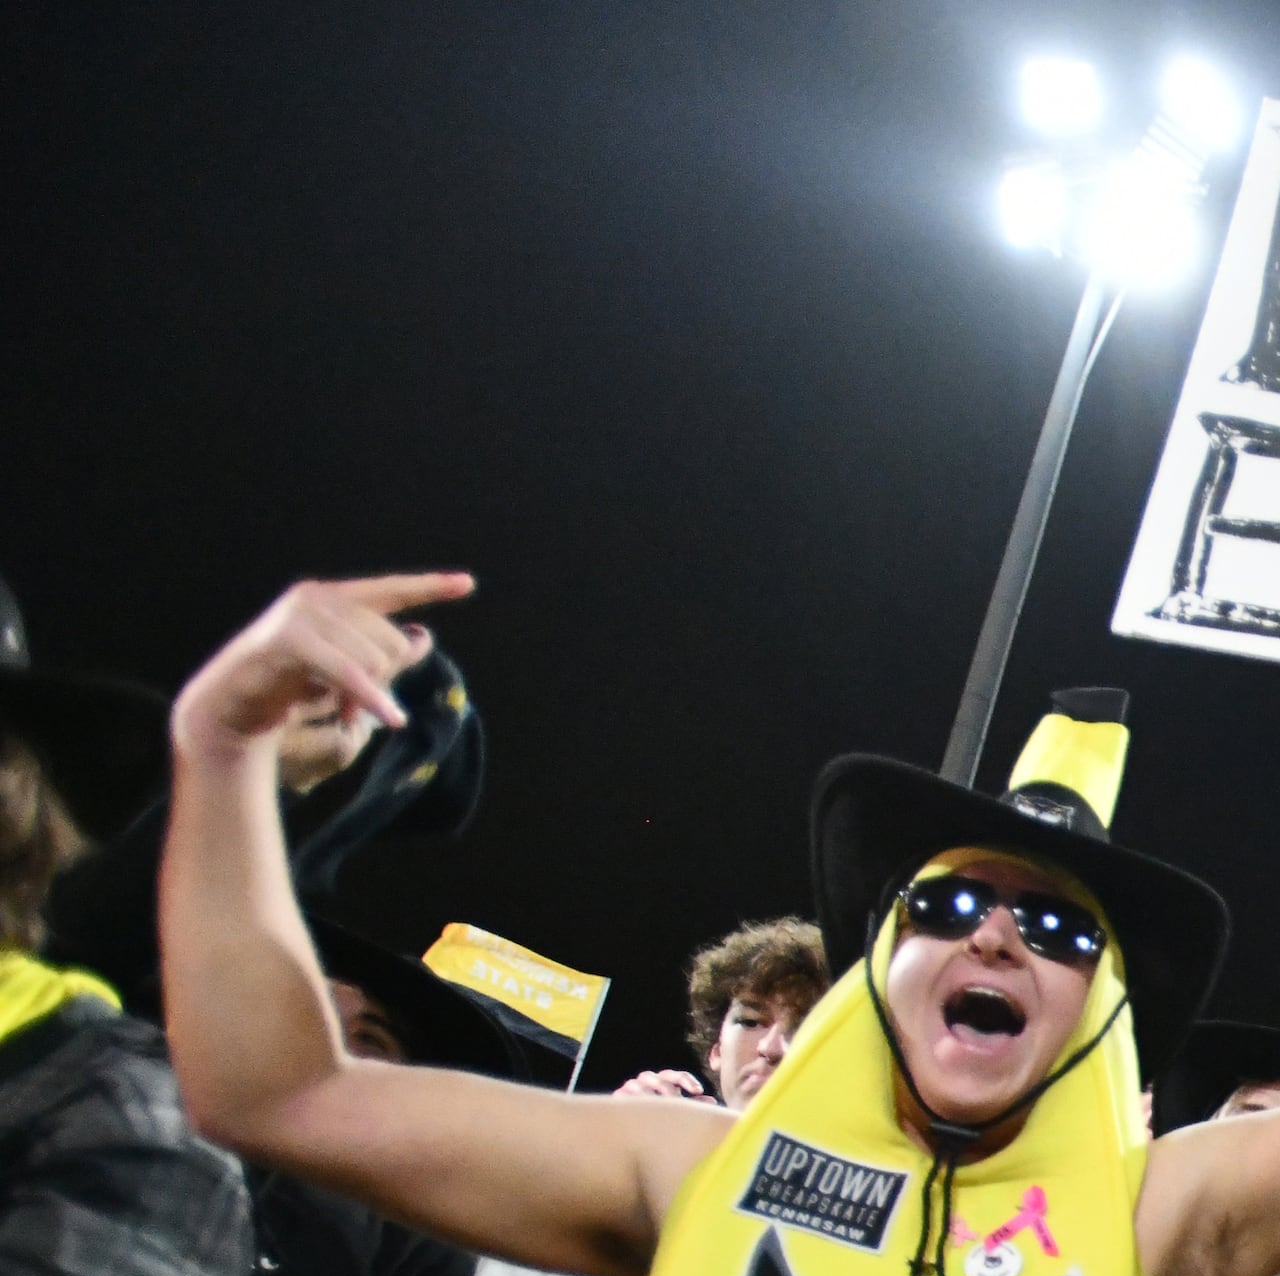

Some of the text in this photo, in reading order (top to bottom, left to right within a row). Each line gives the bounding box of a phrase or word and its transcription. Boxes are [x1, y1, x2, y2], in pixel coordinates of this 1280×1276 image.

[764, 1138, 896, 1208] UPTOWN
[754, 1174, 880, 1228] CHEAPSKATE
[755, 1199, 865, 1241] KENNESAW
